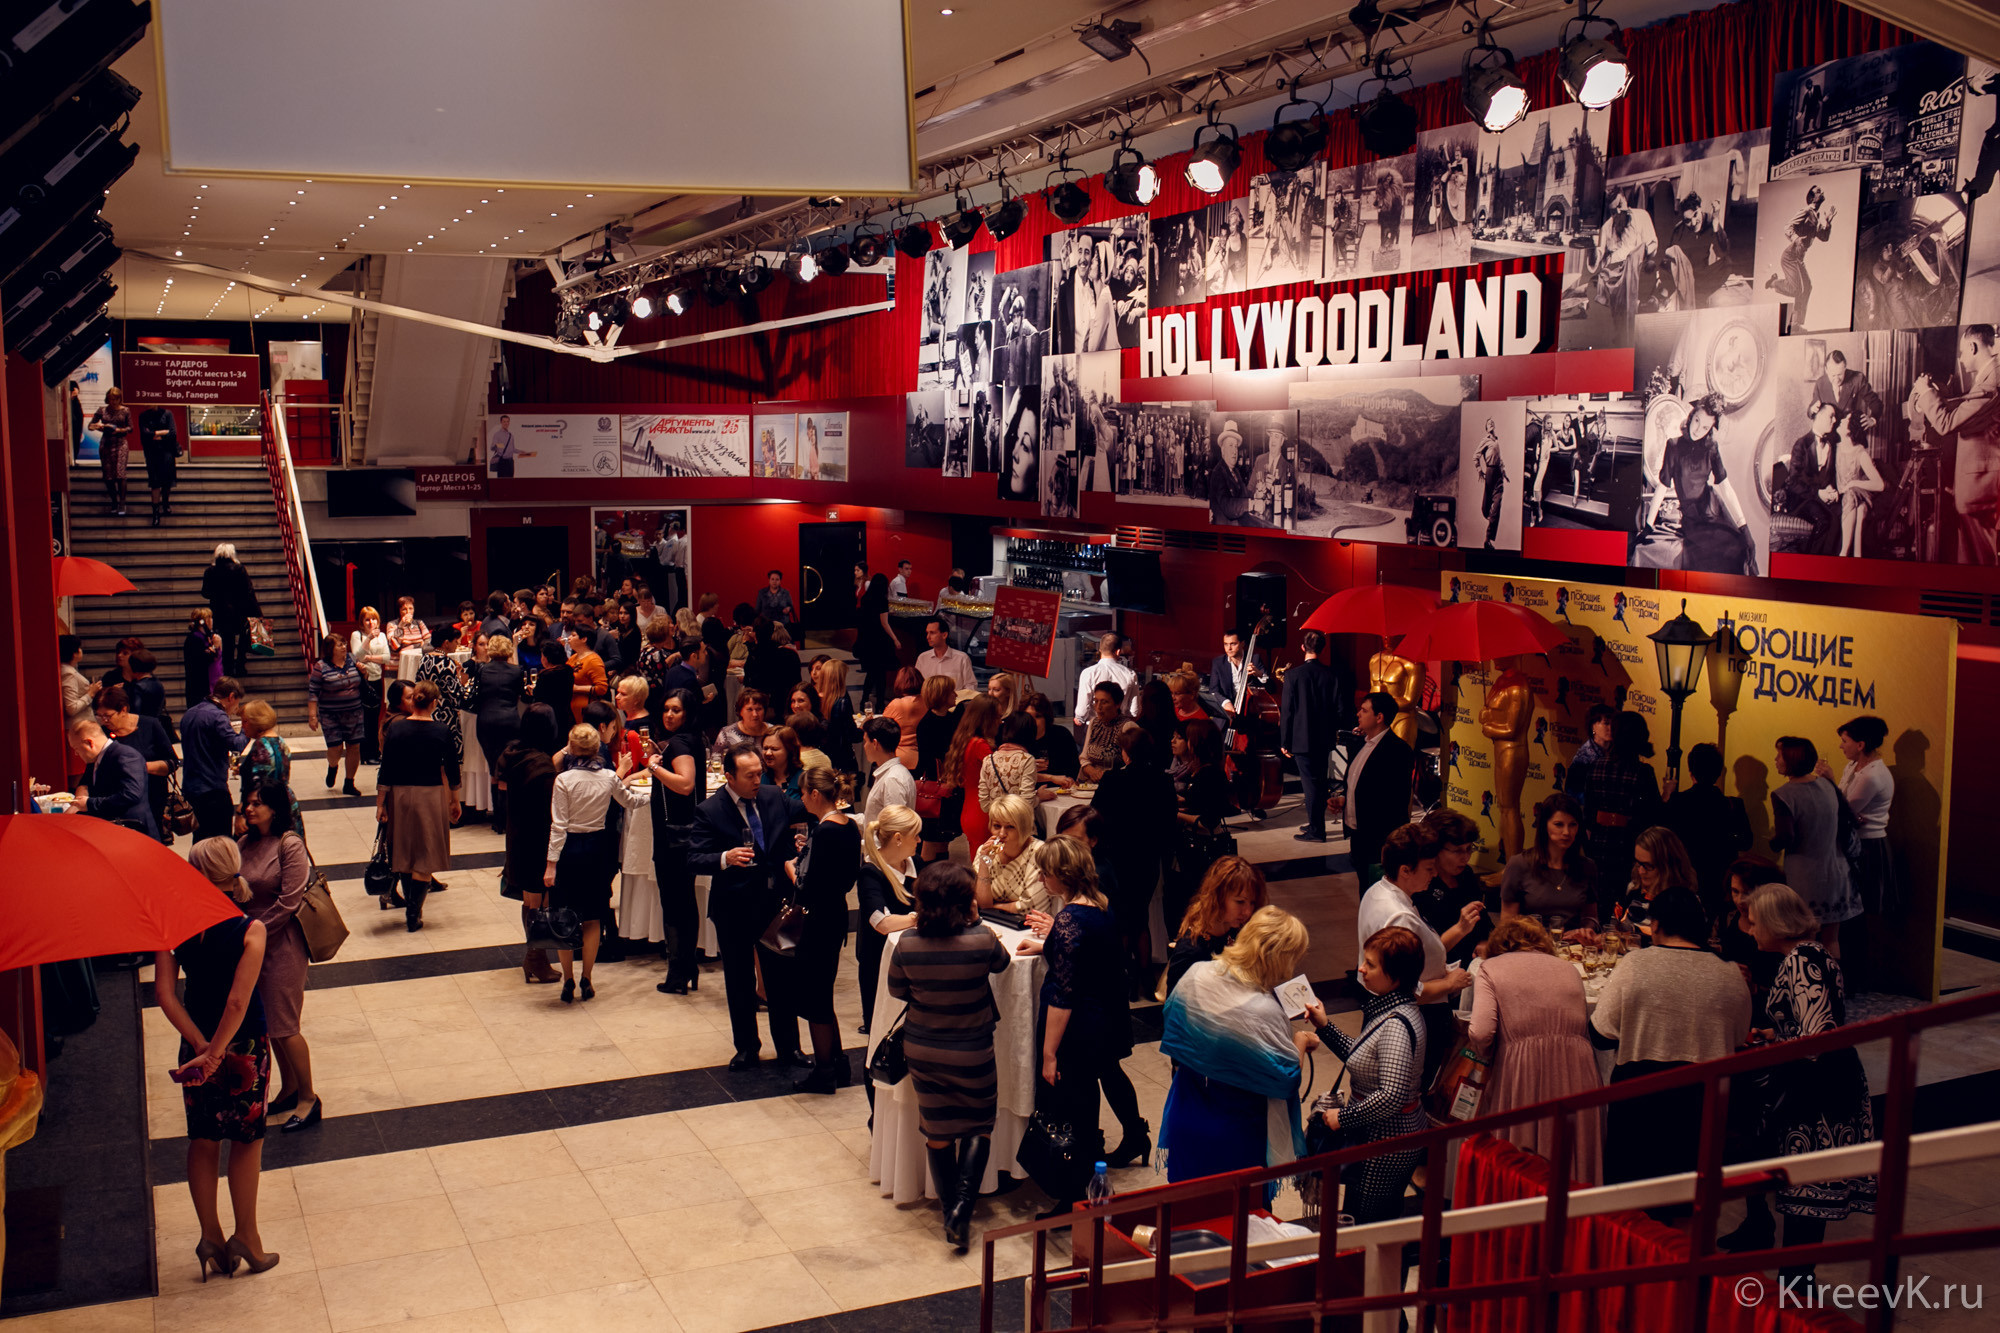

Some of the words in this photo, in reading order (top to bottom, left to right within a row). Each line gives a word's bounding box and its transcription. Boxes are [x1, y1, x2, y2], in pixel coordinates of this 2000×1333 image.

[1921, 115, 1943, 126] WORLD
[1921, 120, 1949, 133] MATINEE
[1916, 127, 1949, 141] FLETCHER
[1139, 272, 1543, 378] HOLLYWOODLAND
[165, 360, 208, 368] ГАРДЕРОБ
[166, 369, 203, 377] БАЛКОН:
[166, 379, 194, 387] Буфет,
[166, 391, 184, 399] Бар,
[186, 391, 219, 399] Галерея
[657, 418, 715, 427] АРГУМЕНТЫ
[421, 473, 476, 483] ГАРДЕРОБ
[1738, 611, 1768, 623] МЮЗИКЛ
[1716, 618, 1854, 669] ПОЮЩИЕ
[1728, 657, 1757, 678] ПОД
[1753, 662, 1876, 710] ДОЖДЕМ
